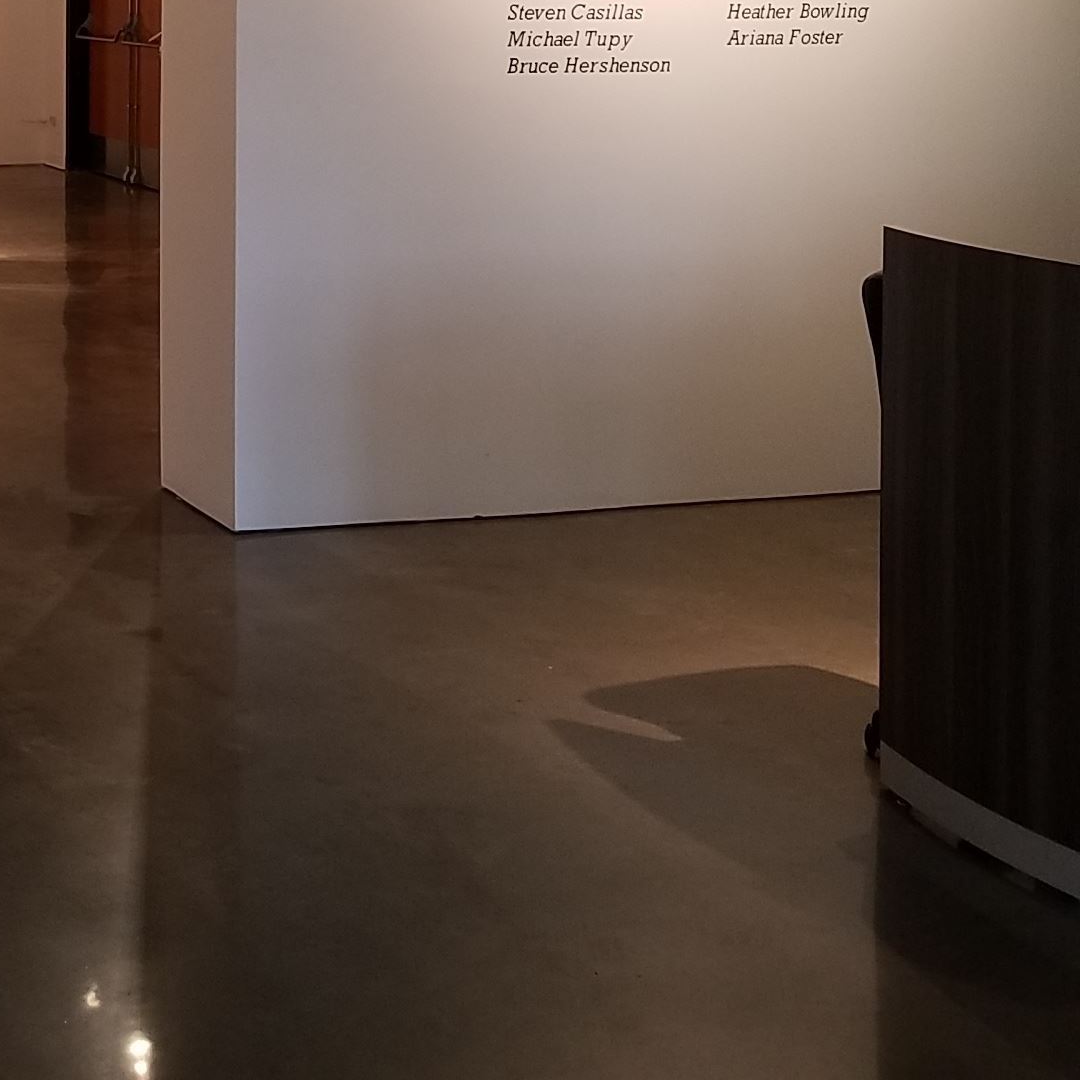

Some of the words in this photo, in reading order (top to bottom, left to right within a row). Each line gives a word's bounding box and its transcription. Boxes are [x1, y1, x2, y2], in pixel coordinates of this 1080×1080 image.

[507, 3, 566, 21] Steven
[570, 3, 644, 21] Casillas
[726, 2, 795, 20] Heather
[799, 2, 870, 23] Bowling
[506, 30, 581, 48] Michael
[584, 29, 634, 52] Tupy
[726, 29, 784, 46] Ariana
[788, 28, 844, 45] Foster
[506, 57, 560, 75] Bruce
[563, 56, 671, 74] Hershenson
